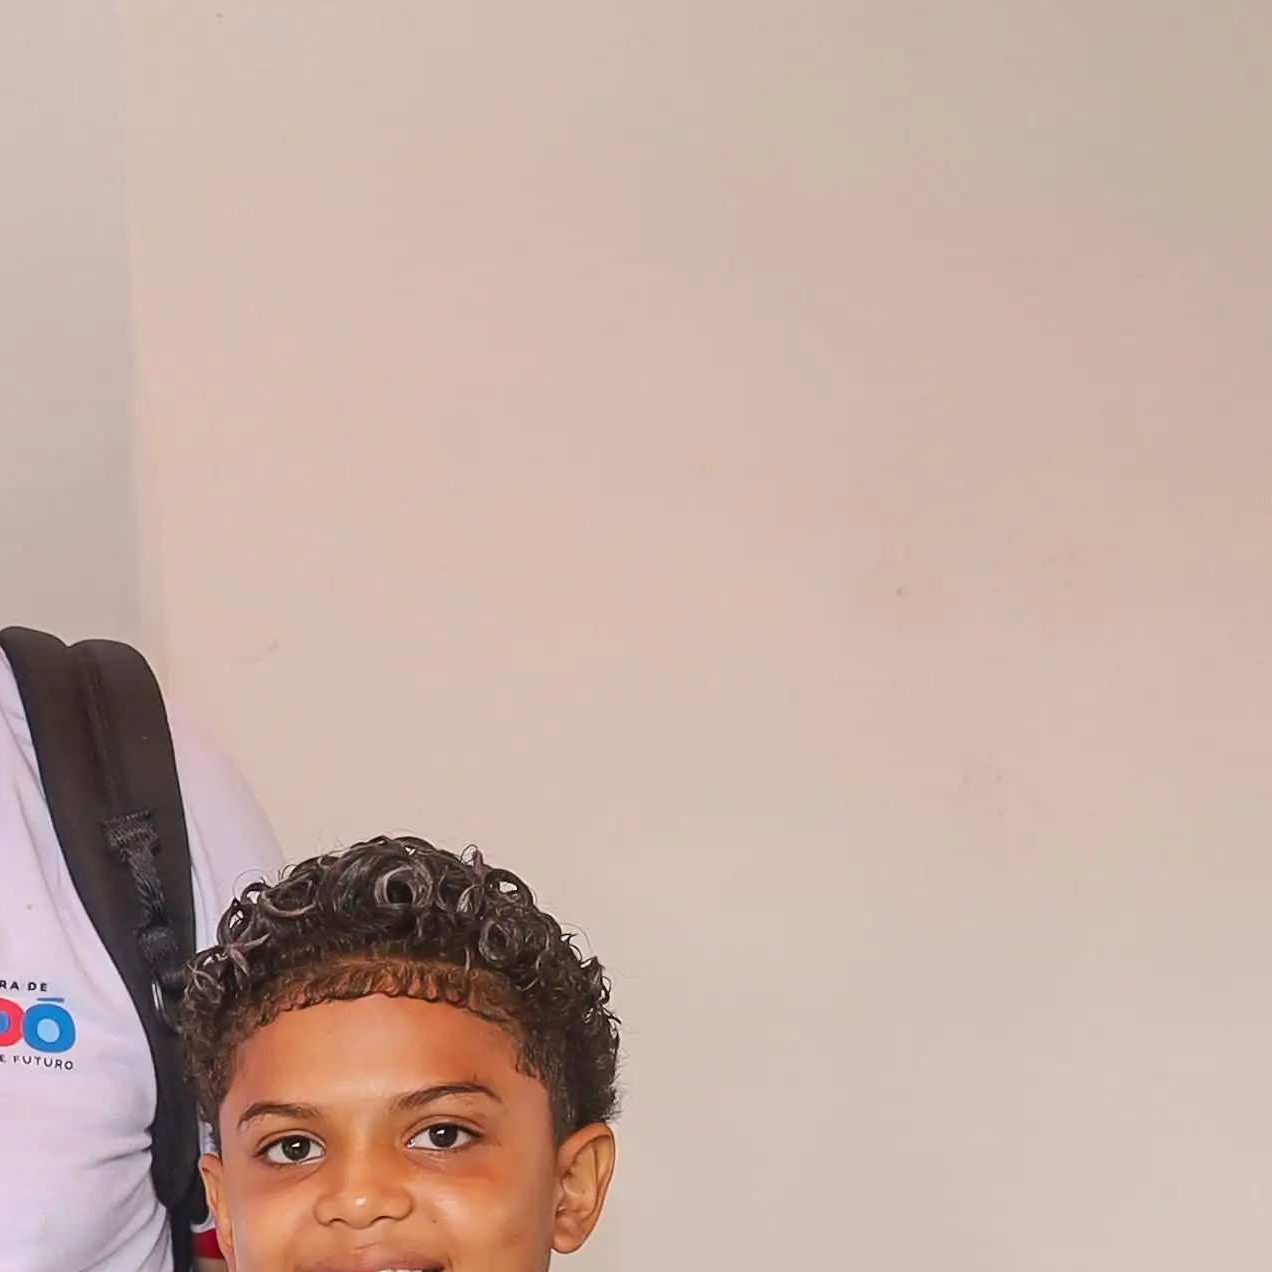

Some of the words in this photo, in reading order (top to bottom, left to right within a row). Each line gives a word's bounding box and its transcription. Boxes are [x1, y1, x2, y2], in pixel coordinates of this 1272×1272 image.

[27, 981, 48, 992] DE
[0, 1053, 7, 1063] E
[13, 1054, 75, 1071] FUTURO
